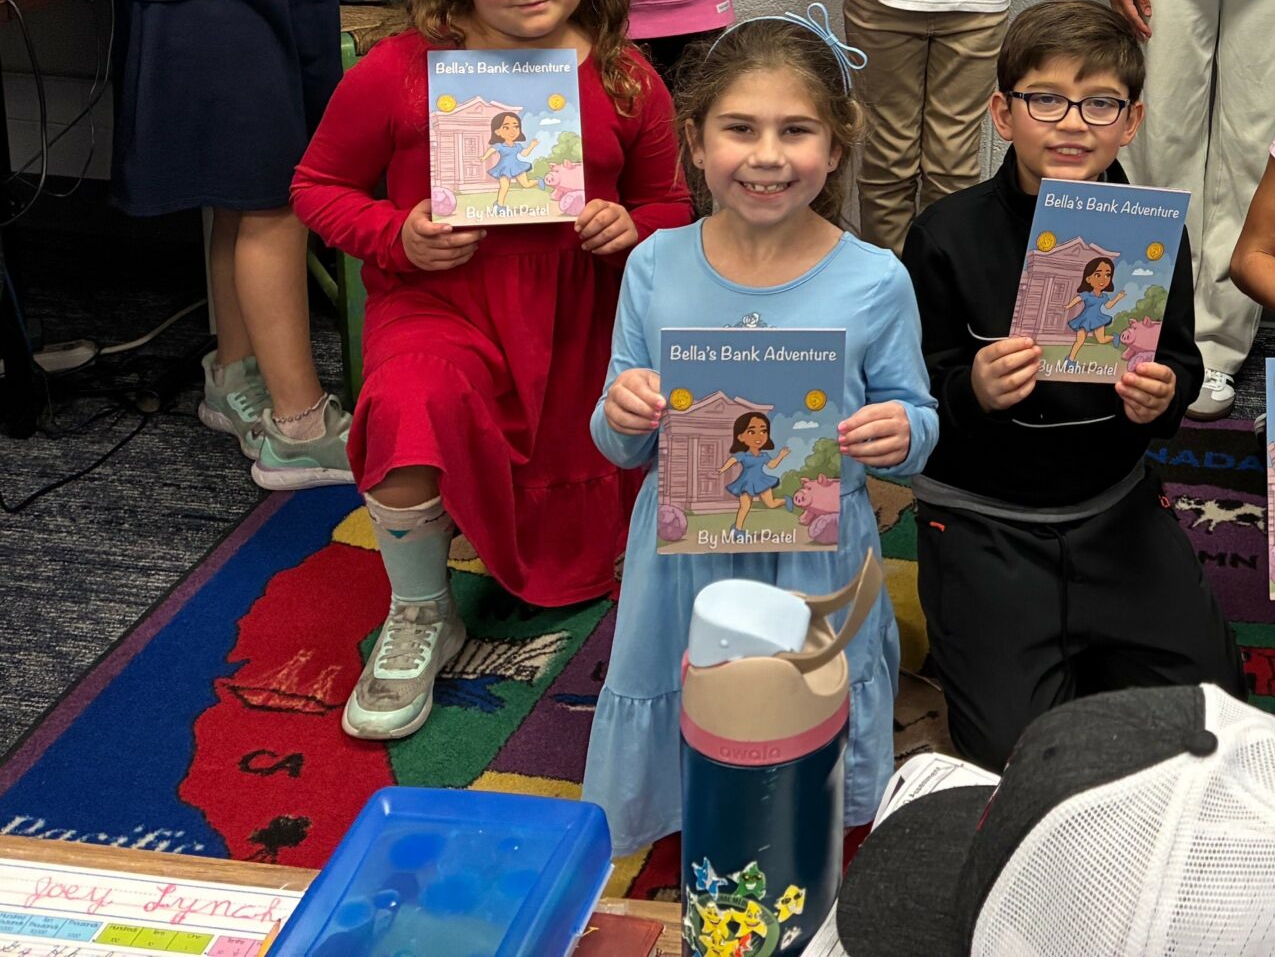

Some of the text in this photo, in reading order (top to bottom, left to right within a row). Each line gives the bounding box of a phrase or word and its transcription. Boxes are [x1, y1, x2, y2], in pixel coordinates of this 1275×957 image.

[436, 62, 570, 74] Bella's Bank Adventure
[519, 204, 549, 216] Patel
[1044, 194, 1179, 219] Bella's Bank Adventure
[670, 346, 837, 361] Bella's Bank Adventure
[1088, 363, 1118, 376] Patel
[698, 529, 796, 549] By Mahi Patel
[719, 744, 781, 762] owala
[25, 877, 284, 924] Joey Lynch
